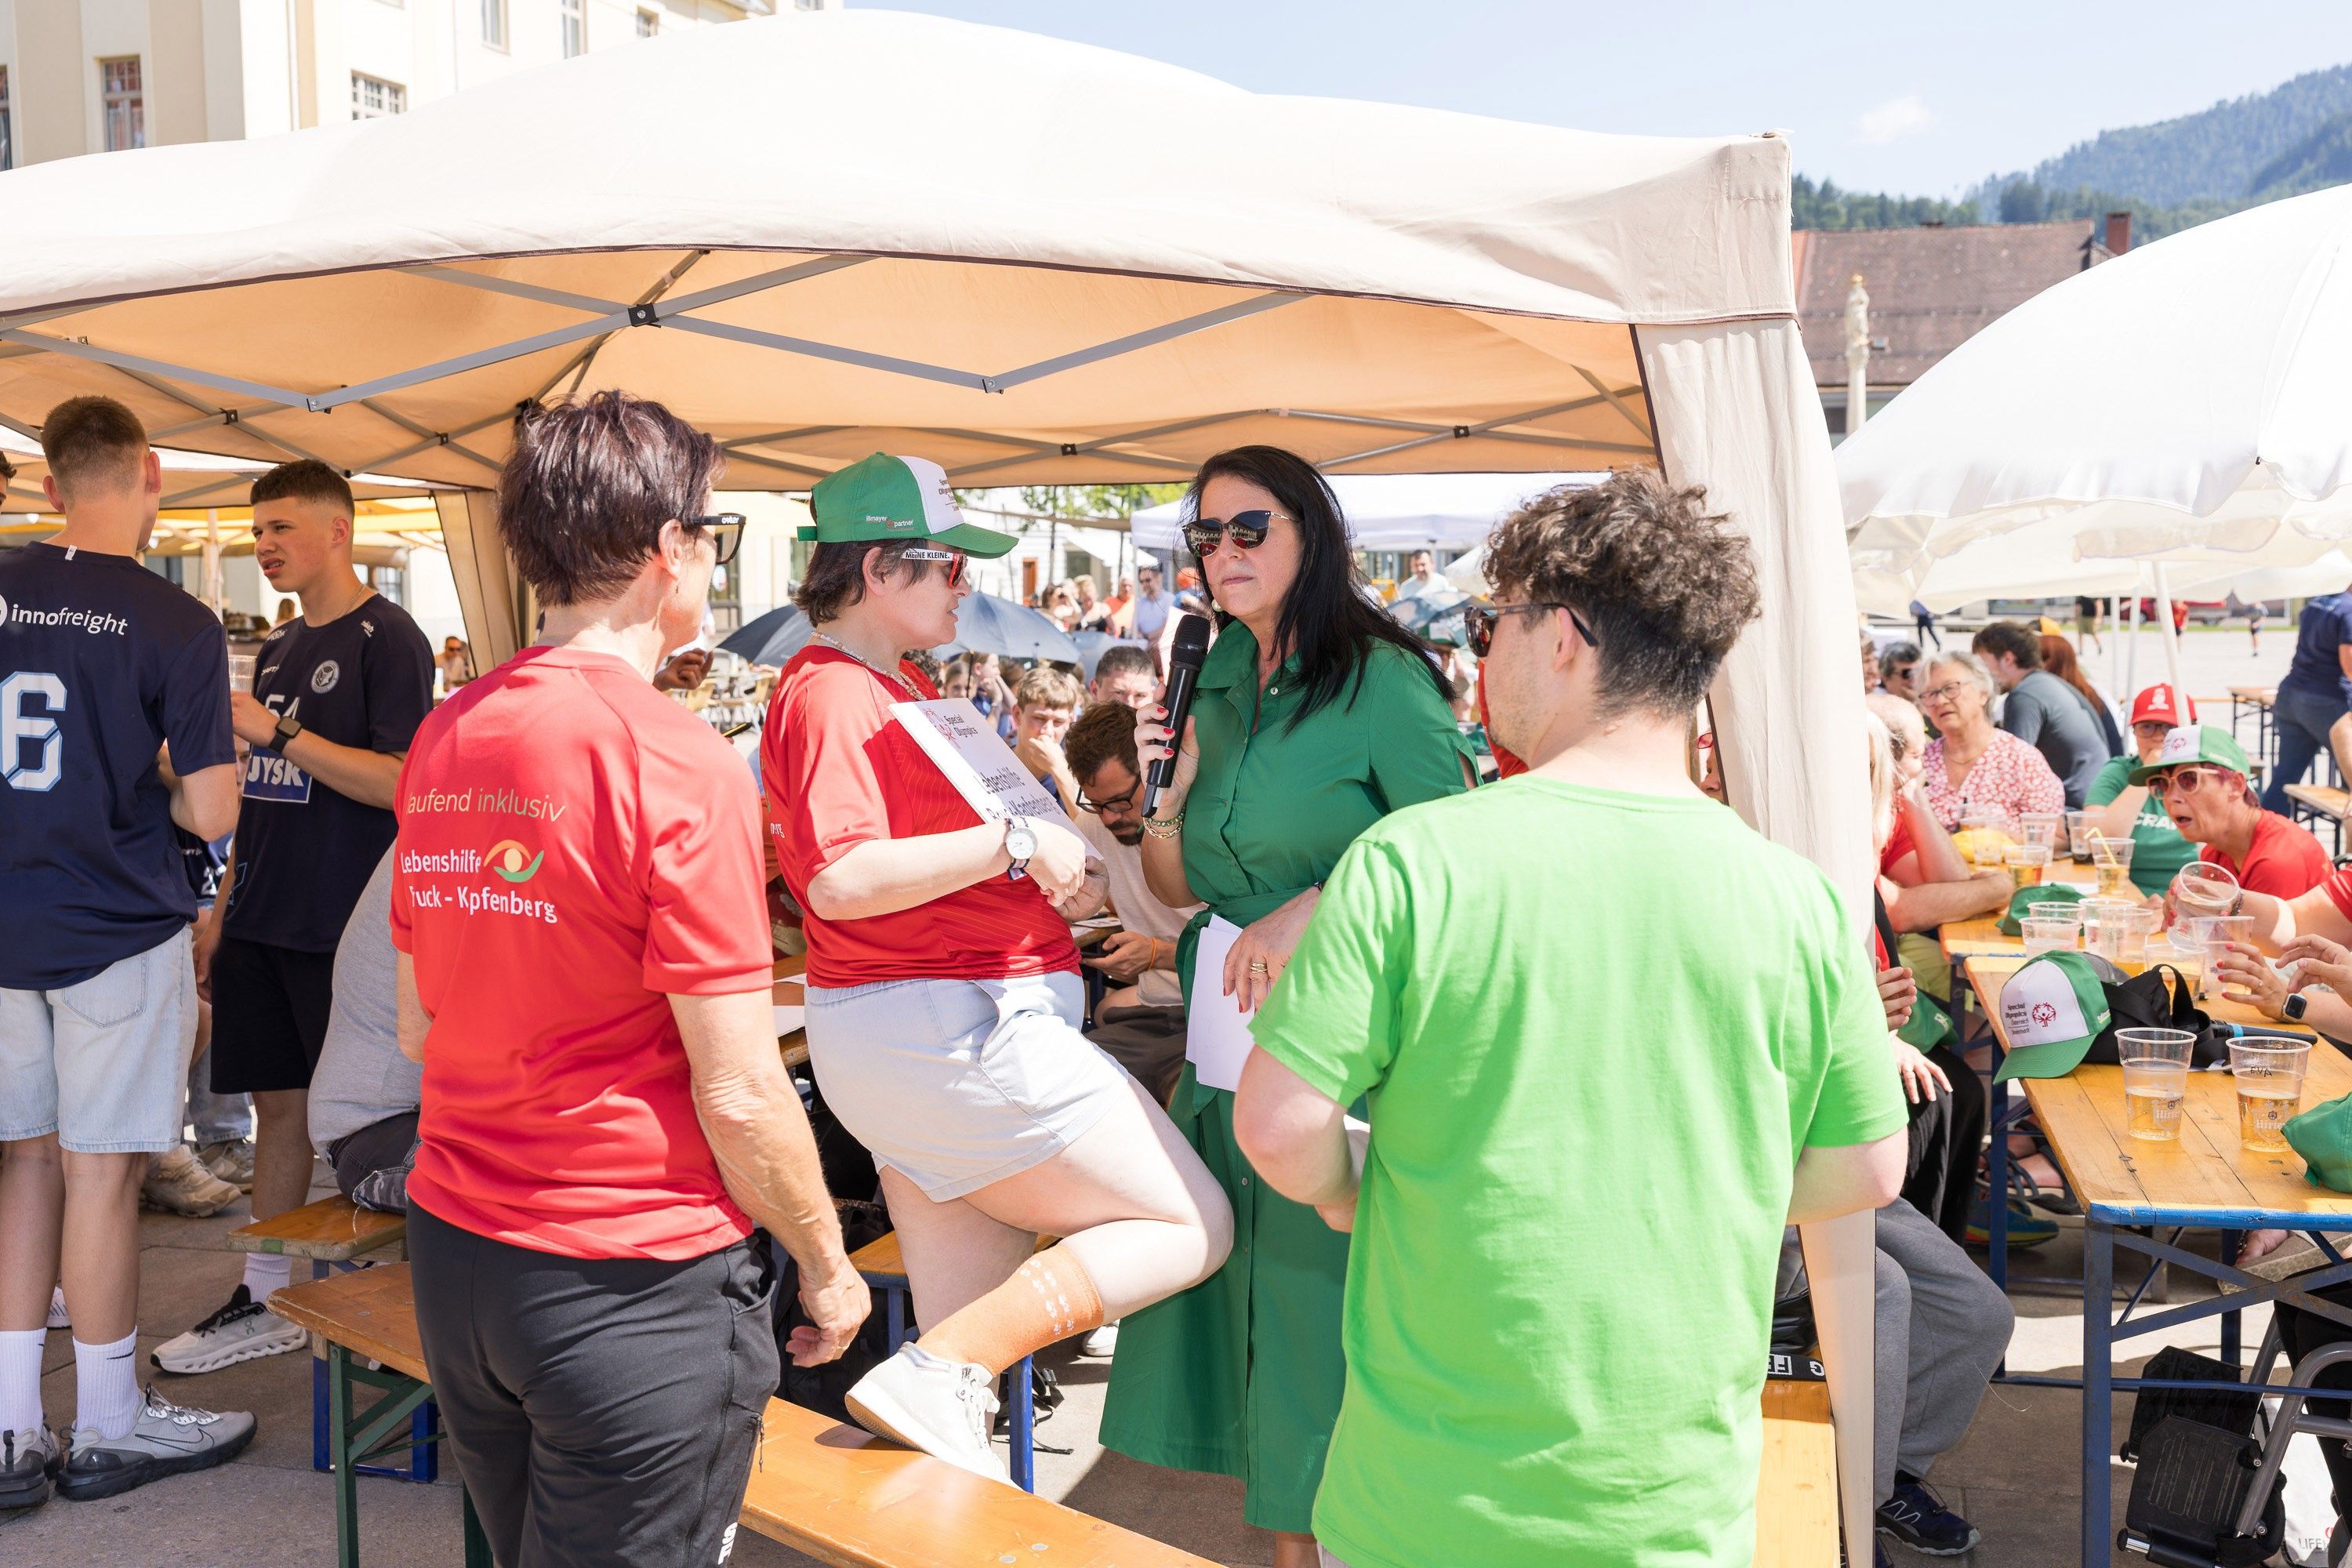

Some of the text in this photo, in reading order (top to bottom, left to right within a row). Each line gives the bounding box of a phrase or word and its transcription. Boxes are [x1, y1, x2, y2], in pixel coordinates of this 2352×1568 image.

[11, 603, 128, 635] innofreight
[0, 671, 67, 792] 6
[944, 714, 965, 726] Special
[953, 726, 978, 738] Olympics
[247, 756, 304, 787] JYSK
[973, 767, 1025, 794] Lebenshilfe
[477, 788, 566, 822] inklusiv
[401, 849, 482, 874] Lebenshilfe
[457, 886, 558, 924] Kpfenberg
[2251, 1066, 2273, 1077] EVA
